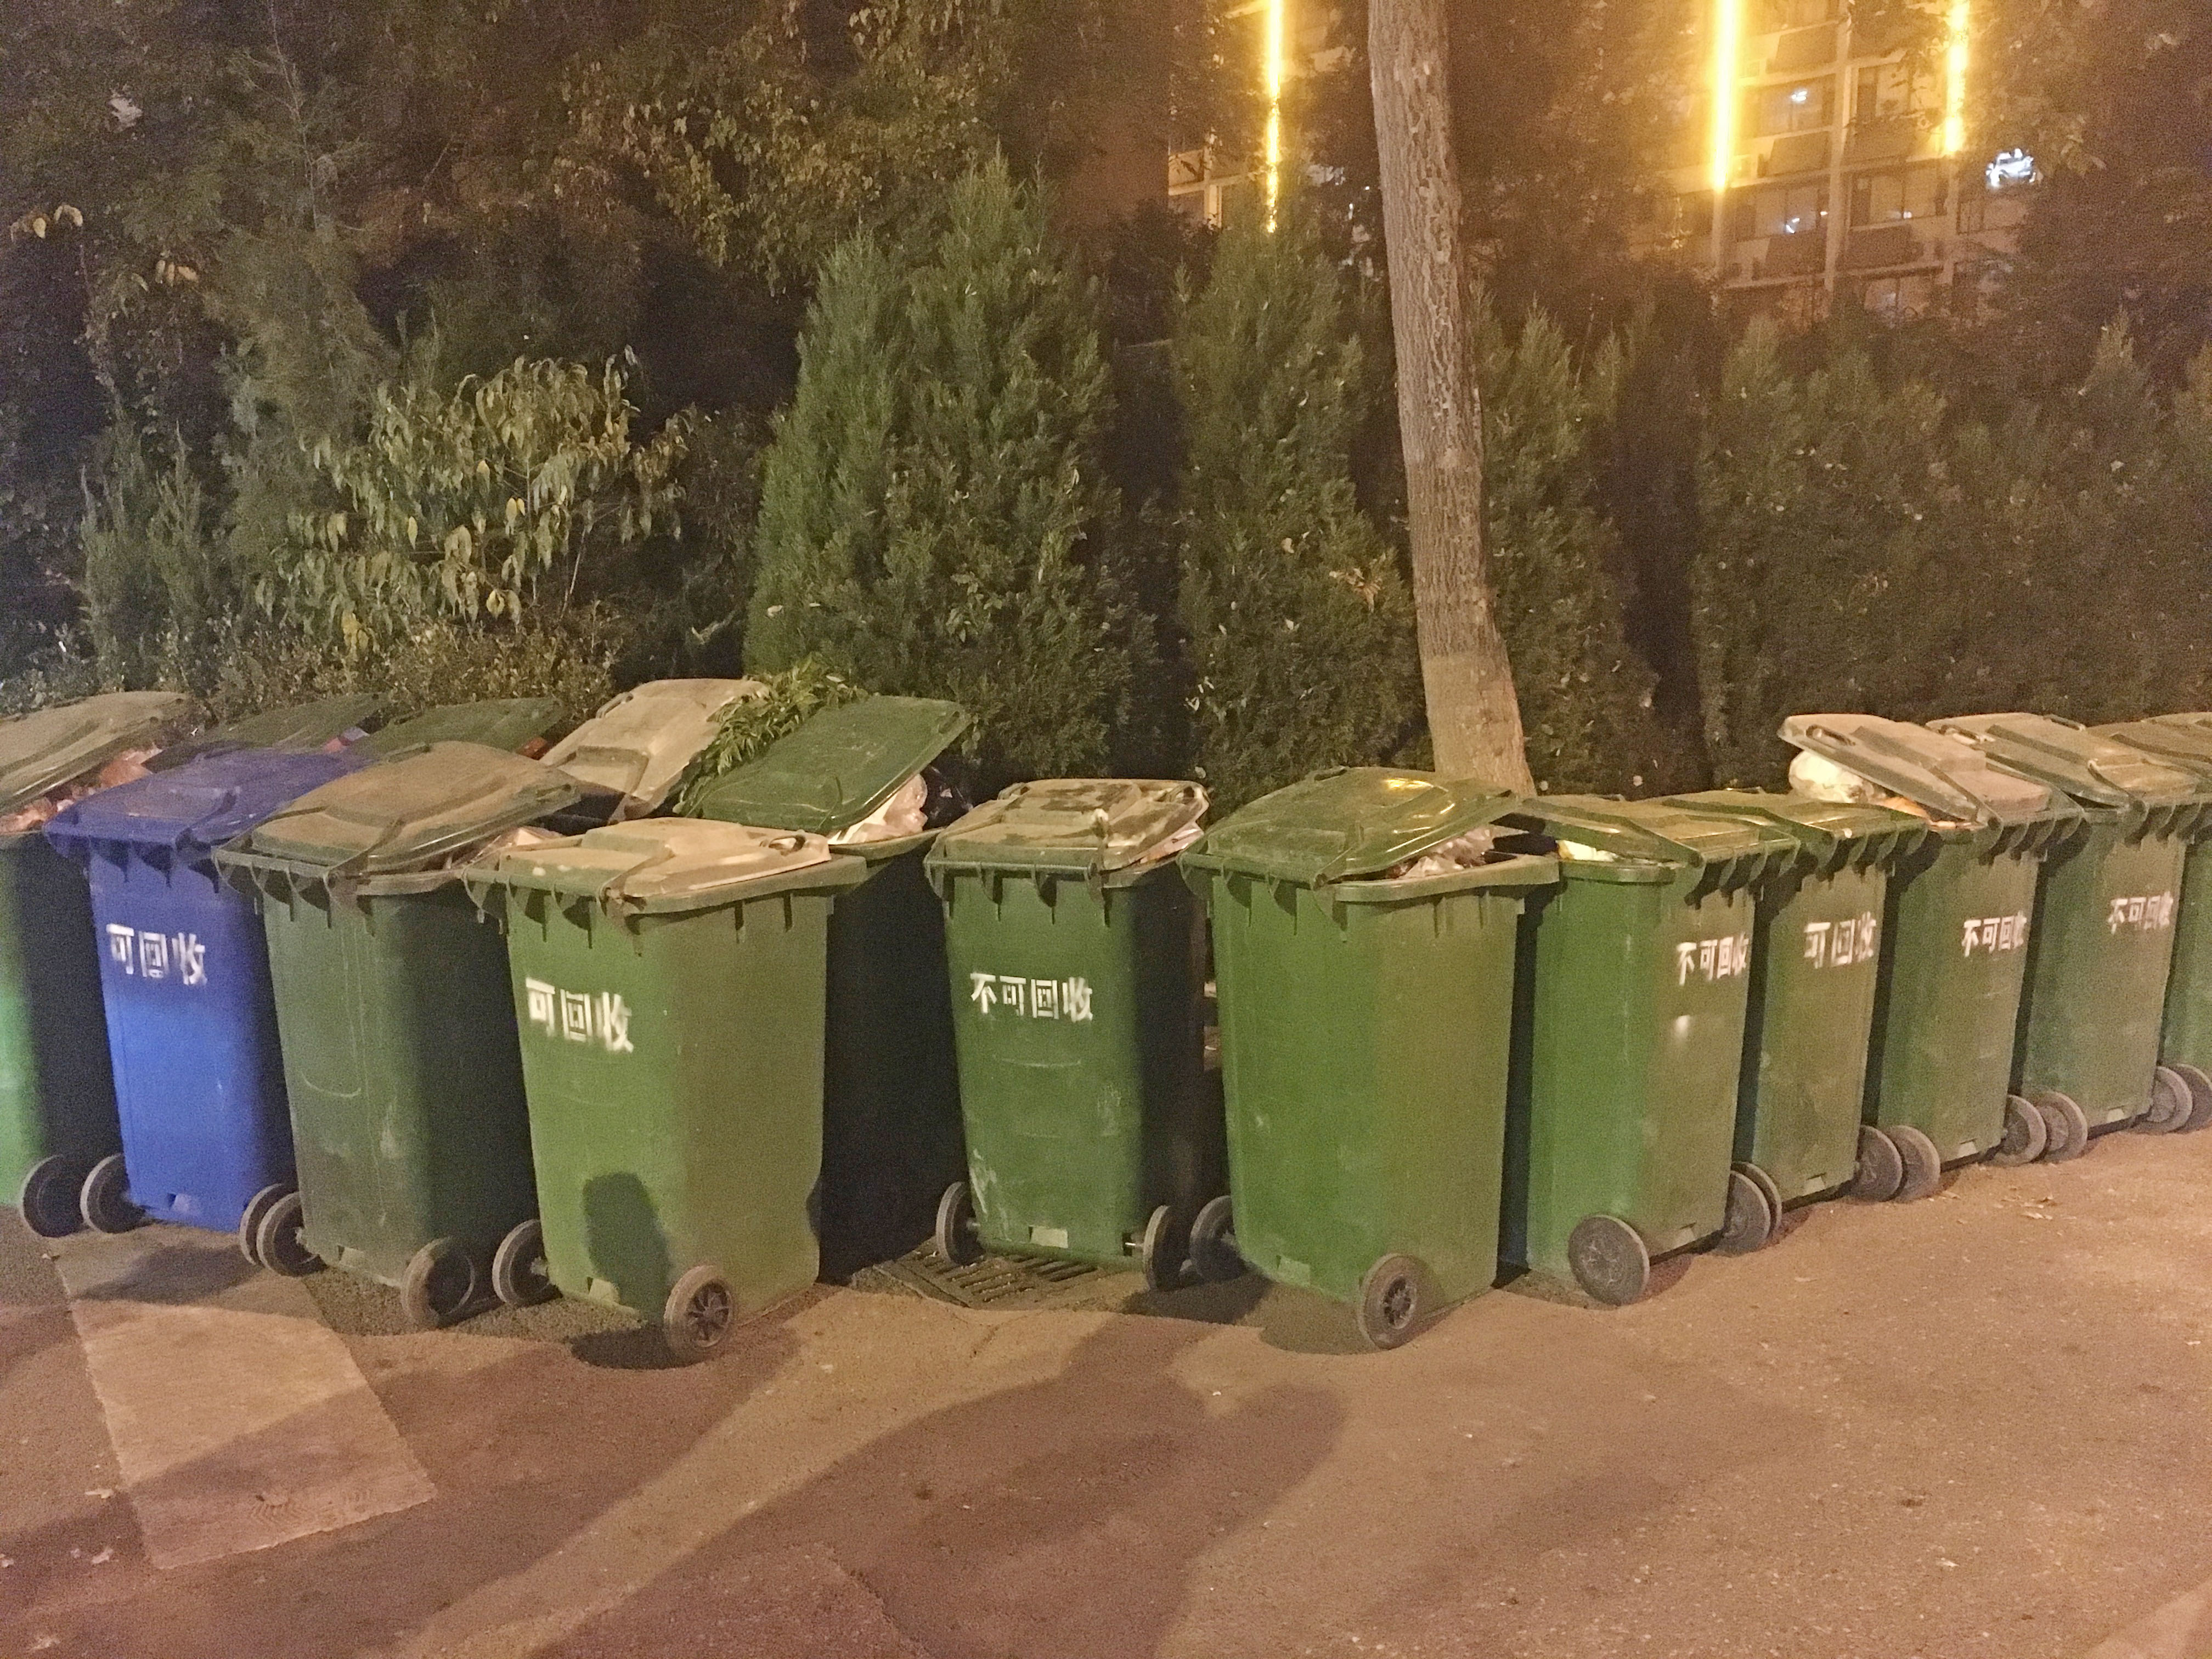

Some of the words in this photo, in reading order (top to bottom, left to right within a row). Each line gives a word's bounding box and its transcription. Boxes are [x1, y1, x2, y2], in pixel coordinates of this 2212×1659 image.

[106, 923, 208, 985] 可回收
[1677, 932, 1749, 986] 不可回收
[1803, 911, 1876, 969] 可回收
[1961, 910, 2027, 957] 不可回收
[526, 977, 634, 1053] 可回收
[970, 973, 1093, 1022] 不可回收
